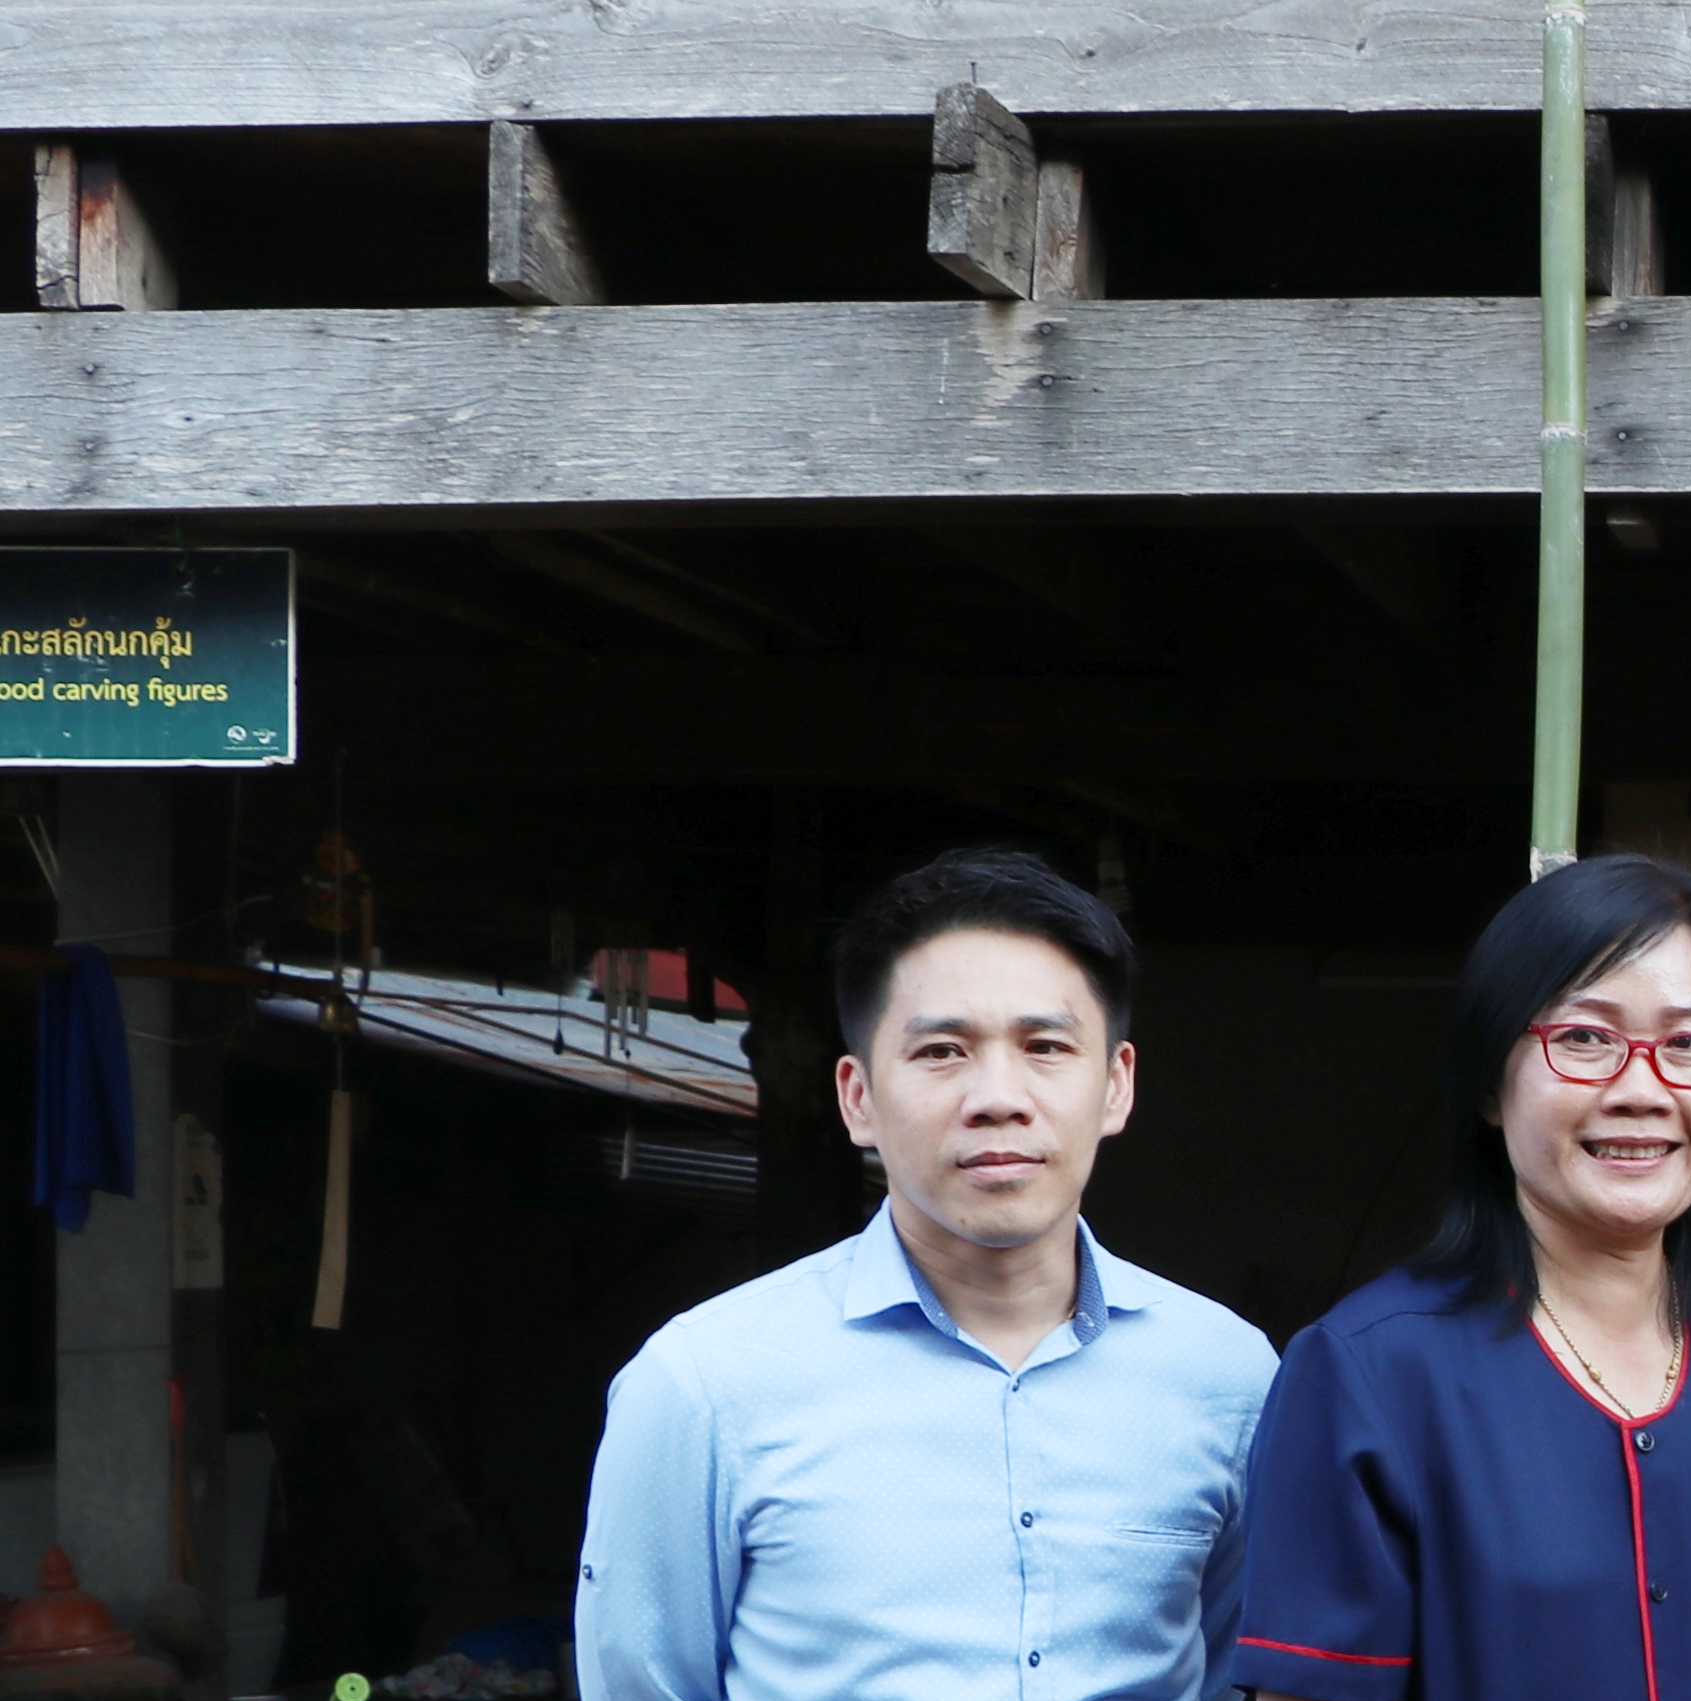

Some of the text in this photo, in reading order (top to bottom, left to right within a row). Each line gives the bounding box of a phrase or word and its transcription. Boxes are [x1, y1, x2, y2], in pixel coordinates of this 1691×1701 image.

[0, 617, 193, 669] กะสลักนกคุ้ม
[0, 677, 228, 707] ood carving figures
